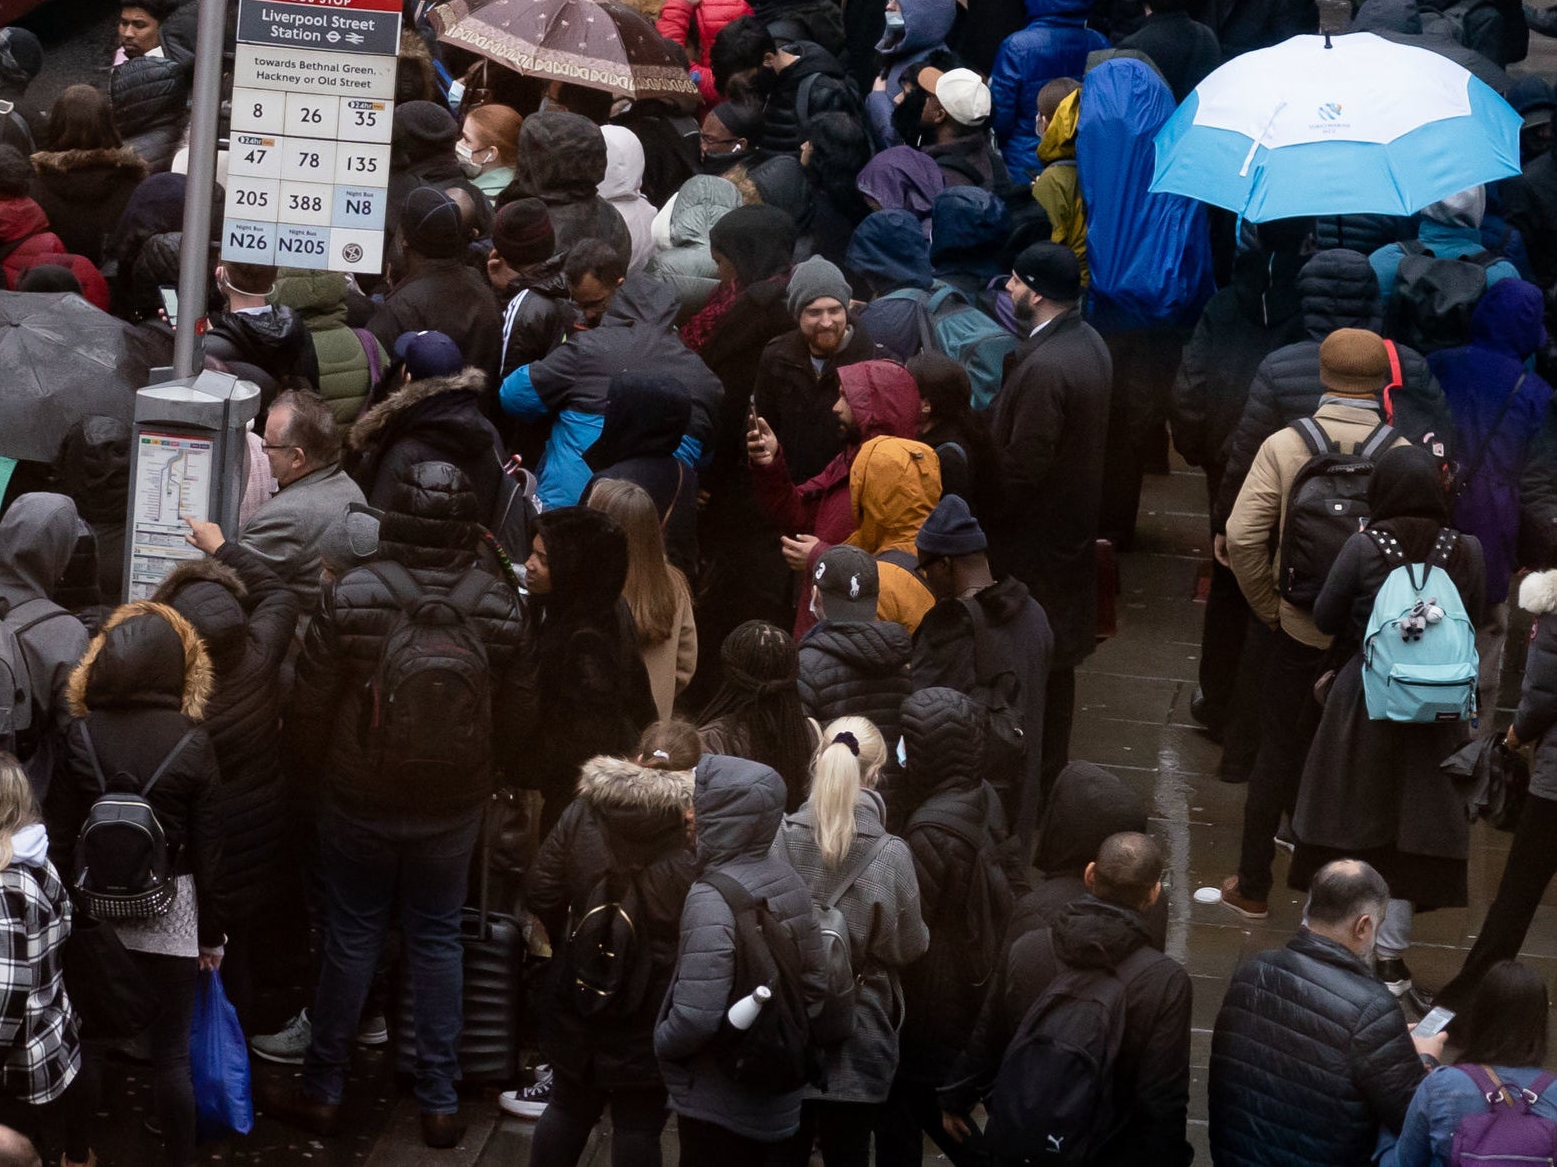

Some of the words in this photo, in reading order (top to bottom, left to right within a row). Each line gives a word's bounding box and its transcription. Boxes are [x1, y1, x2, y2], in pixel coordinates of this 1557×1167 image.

[261, 8, 328, 27] Liverpool
[331, 15, 376, 32] Street
[270, 24, 322, 42] Station
[254, 56, 297, 70] towards
[299, 59, 340, 73] Bethnal
[256, 69, 301, 85] Hackney
[303, 75, 315, 84] or
[317, 75, 337, 86] Old
[339, 77, 372, 90] Street
[252, 103, 264, 119] 8
[300, 107, 323, 124] 26
[354, 111, 377, 127] 35
[243, 136, 262, 146] 24hr
[244, 149, 267, 165] 47
[298, 152, 320, 168] 78
[346, 156, 378, 173] 135
[235, 189, 269, 207] 205
[288, 194, 323, 212] 388
[345, 199, 372, 216] N8
[229, 232, 268, 250] N26
[278, 237, 326, 255] N205
